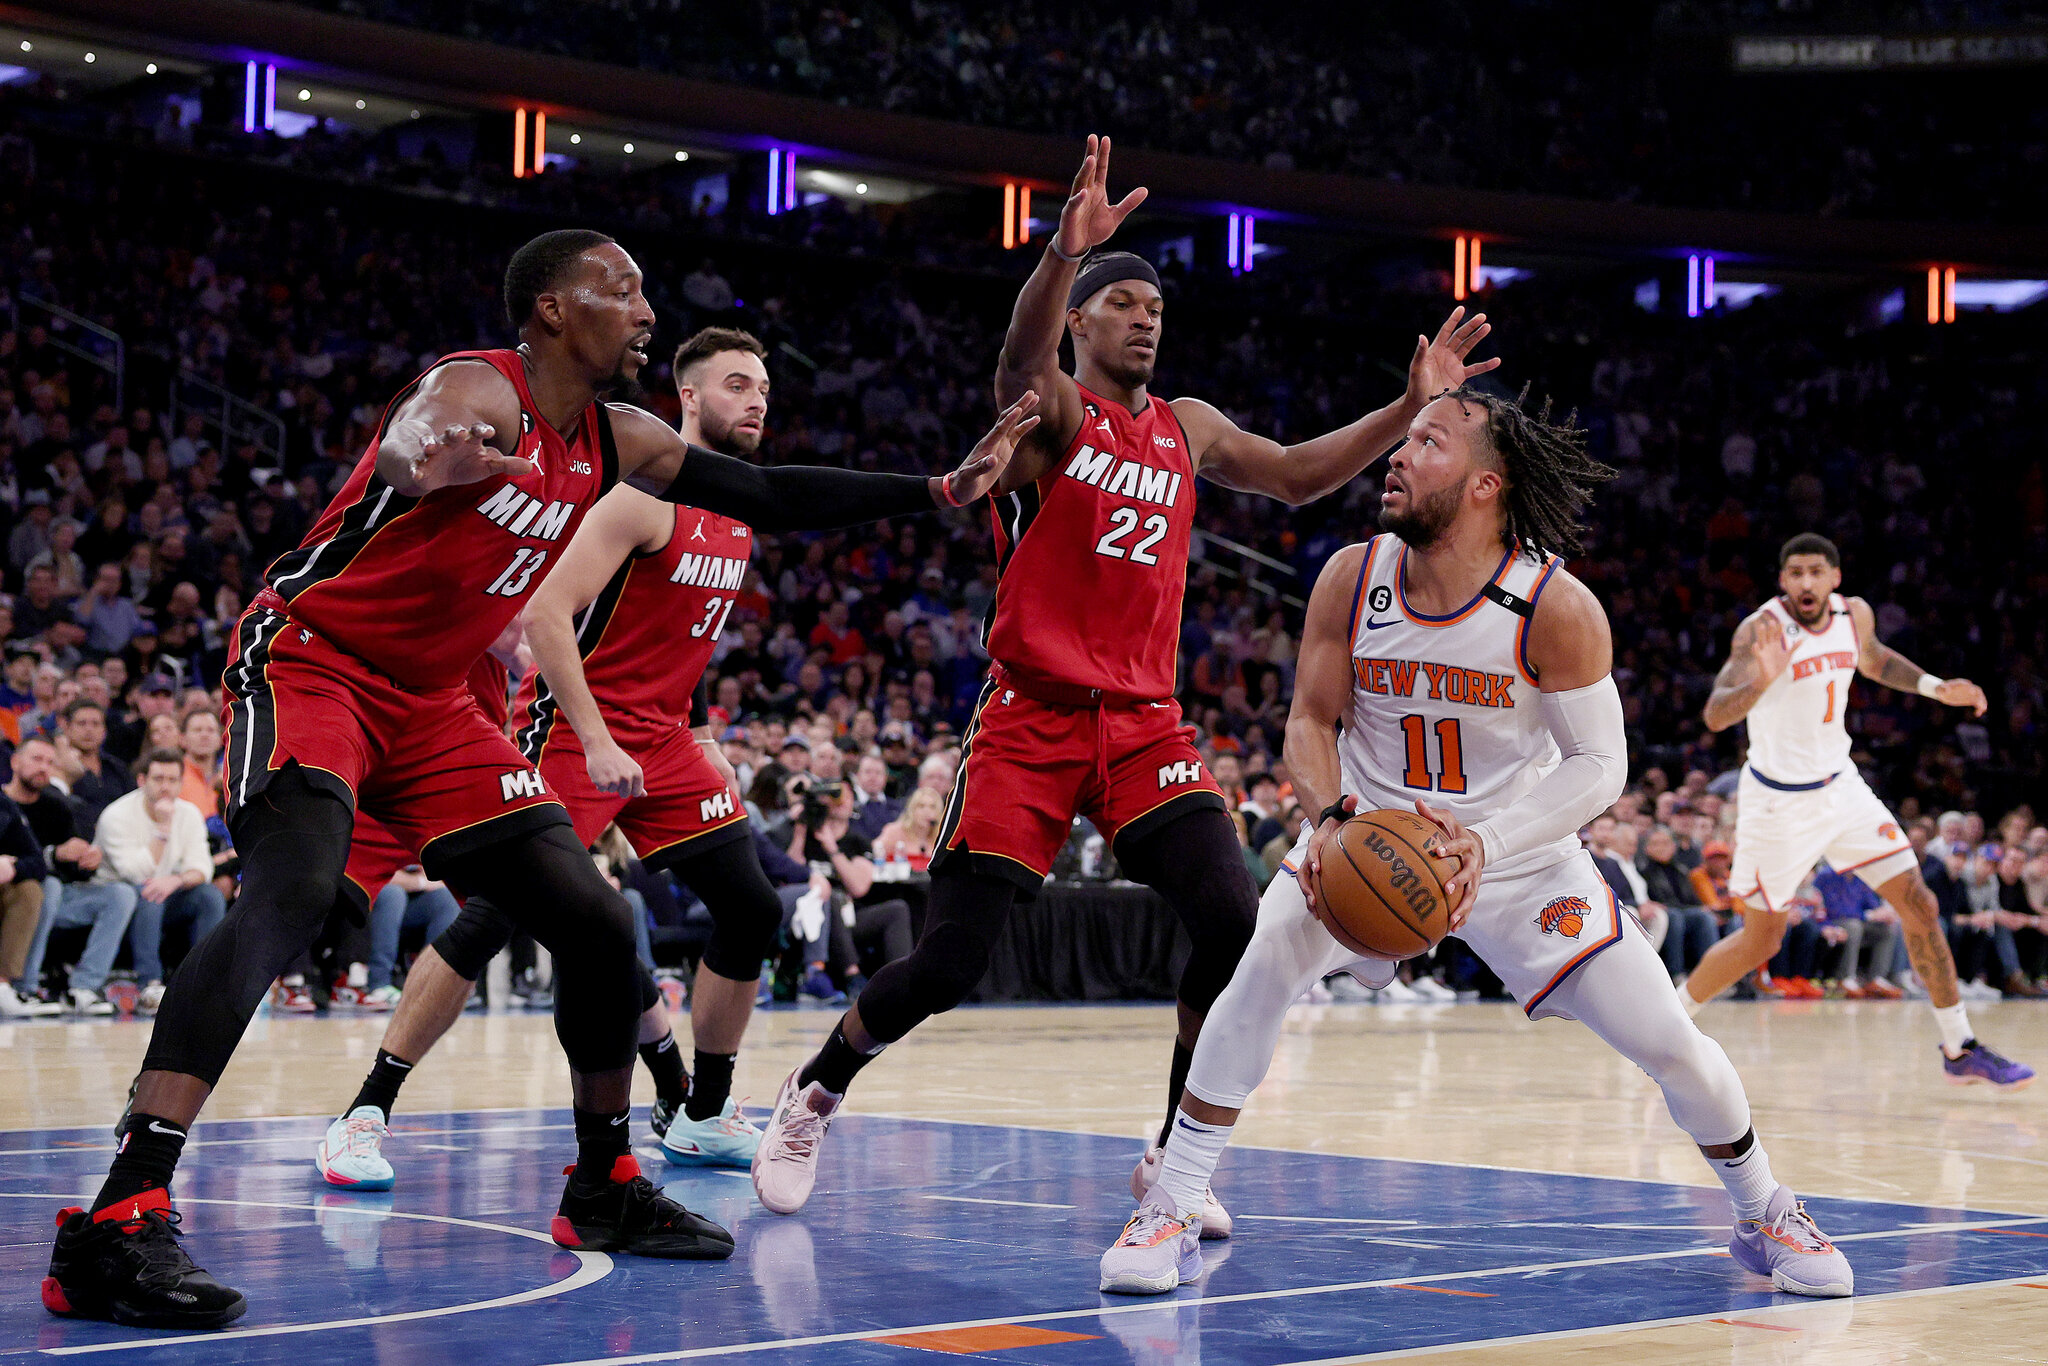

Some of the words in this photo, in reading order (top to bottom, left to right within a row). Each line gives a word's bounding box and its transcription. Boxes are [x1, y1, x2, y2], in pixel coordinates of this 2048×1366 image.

[1799, 39, 1873, 66] LIGHT
[1095, 506, 1169, 566] 22
[483, 546, 548, 597] 13
[669, 552, 747, 591] MIAMI
[690, 596, 735, 642] 31
[1373, 589, 1388, 609] 6
[1502, 594, 1513, 606] 19
[1354, 658, 1419, 697] NEW
[1423, 662, 1515, 708] YORK
[1823, 680, 1835, 724] 1
[1400, 714, 1467, 794] 11
[1363, 831, 1437, 923] Wilson
[1540, 896, 1592, 932] KNICKS
